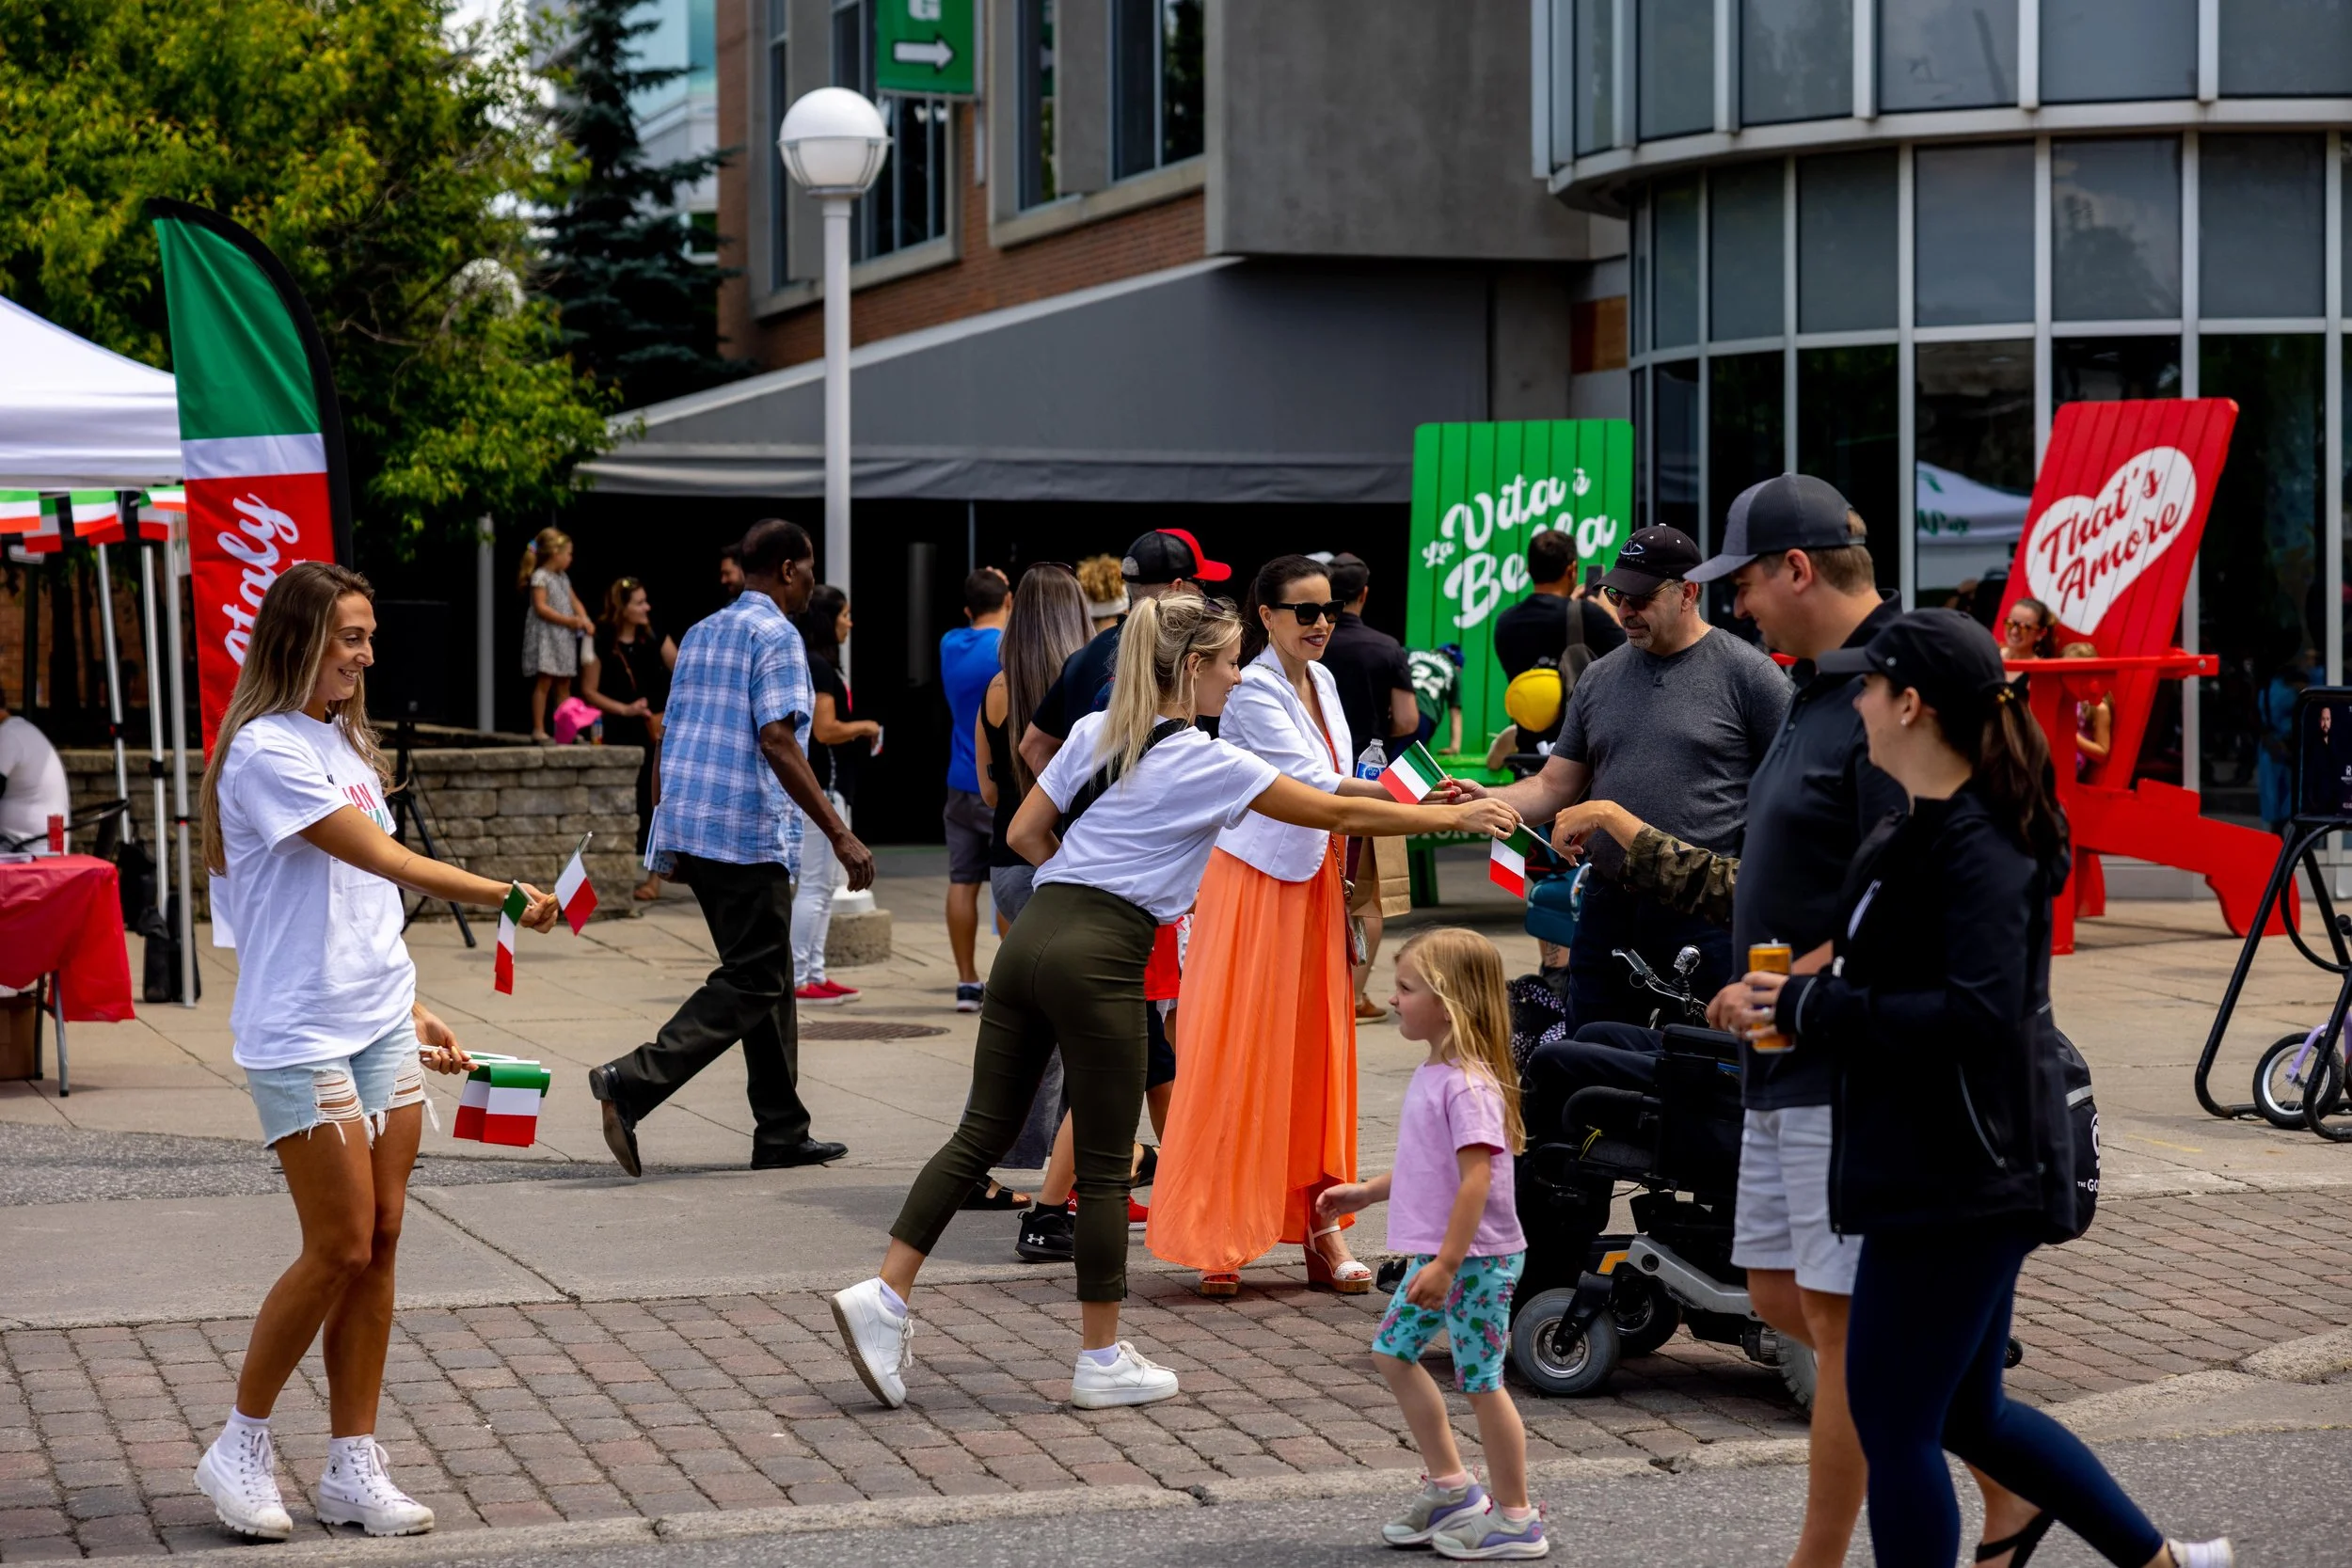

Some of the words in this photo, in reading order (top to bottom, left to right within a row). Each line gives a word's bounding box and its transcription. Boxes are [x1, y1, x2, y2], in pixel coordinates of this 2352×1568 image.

[1421, 539, 1455, 568] La
[1440, 473, 1566, 551] Vita
[1442, 512, 1617, 629] Bea
[2039, 467, 2163, 574] That's
[2058, 501, 2183, 615] Amore
